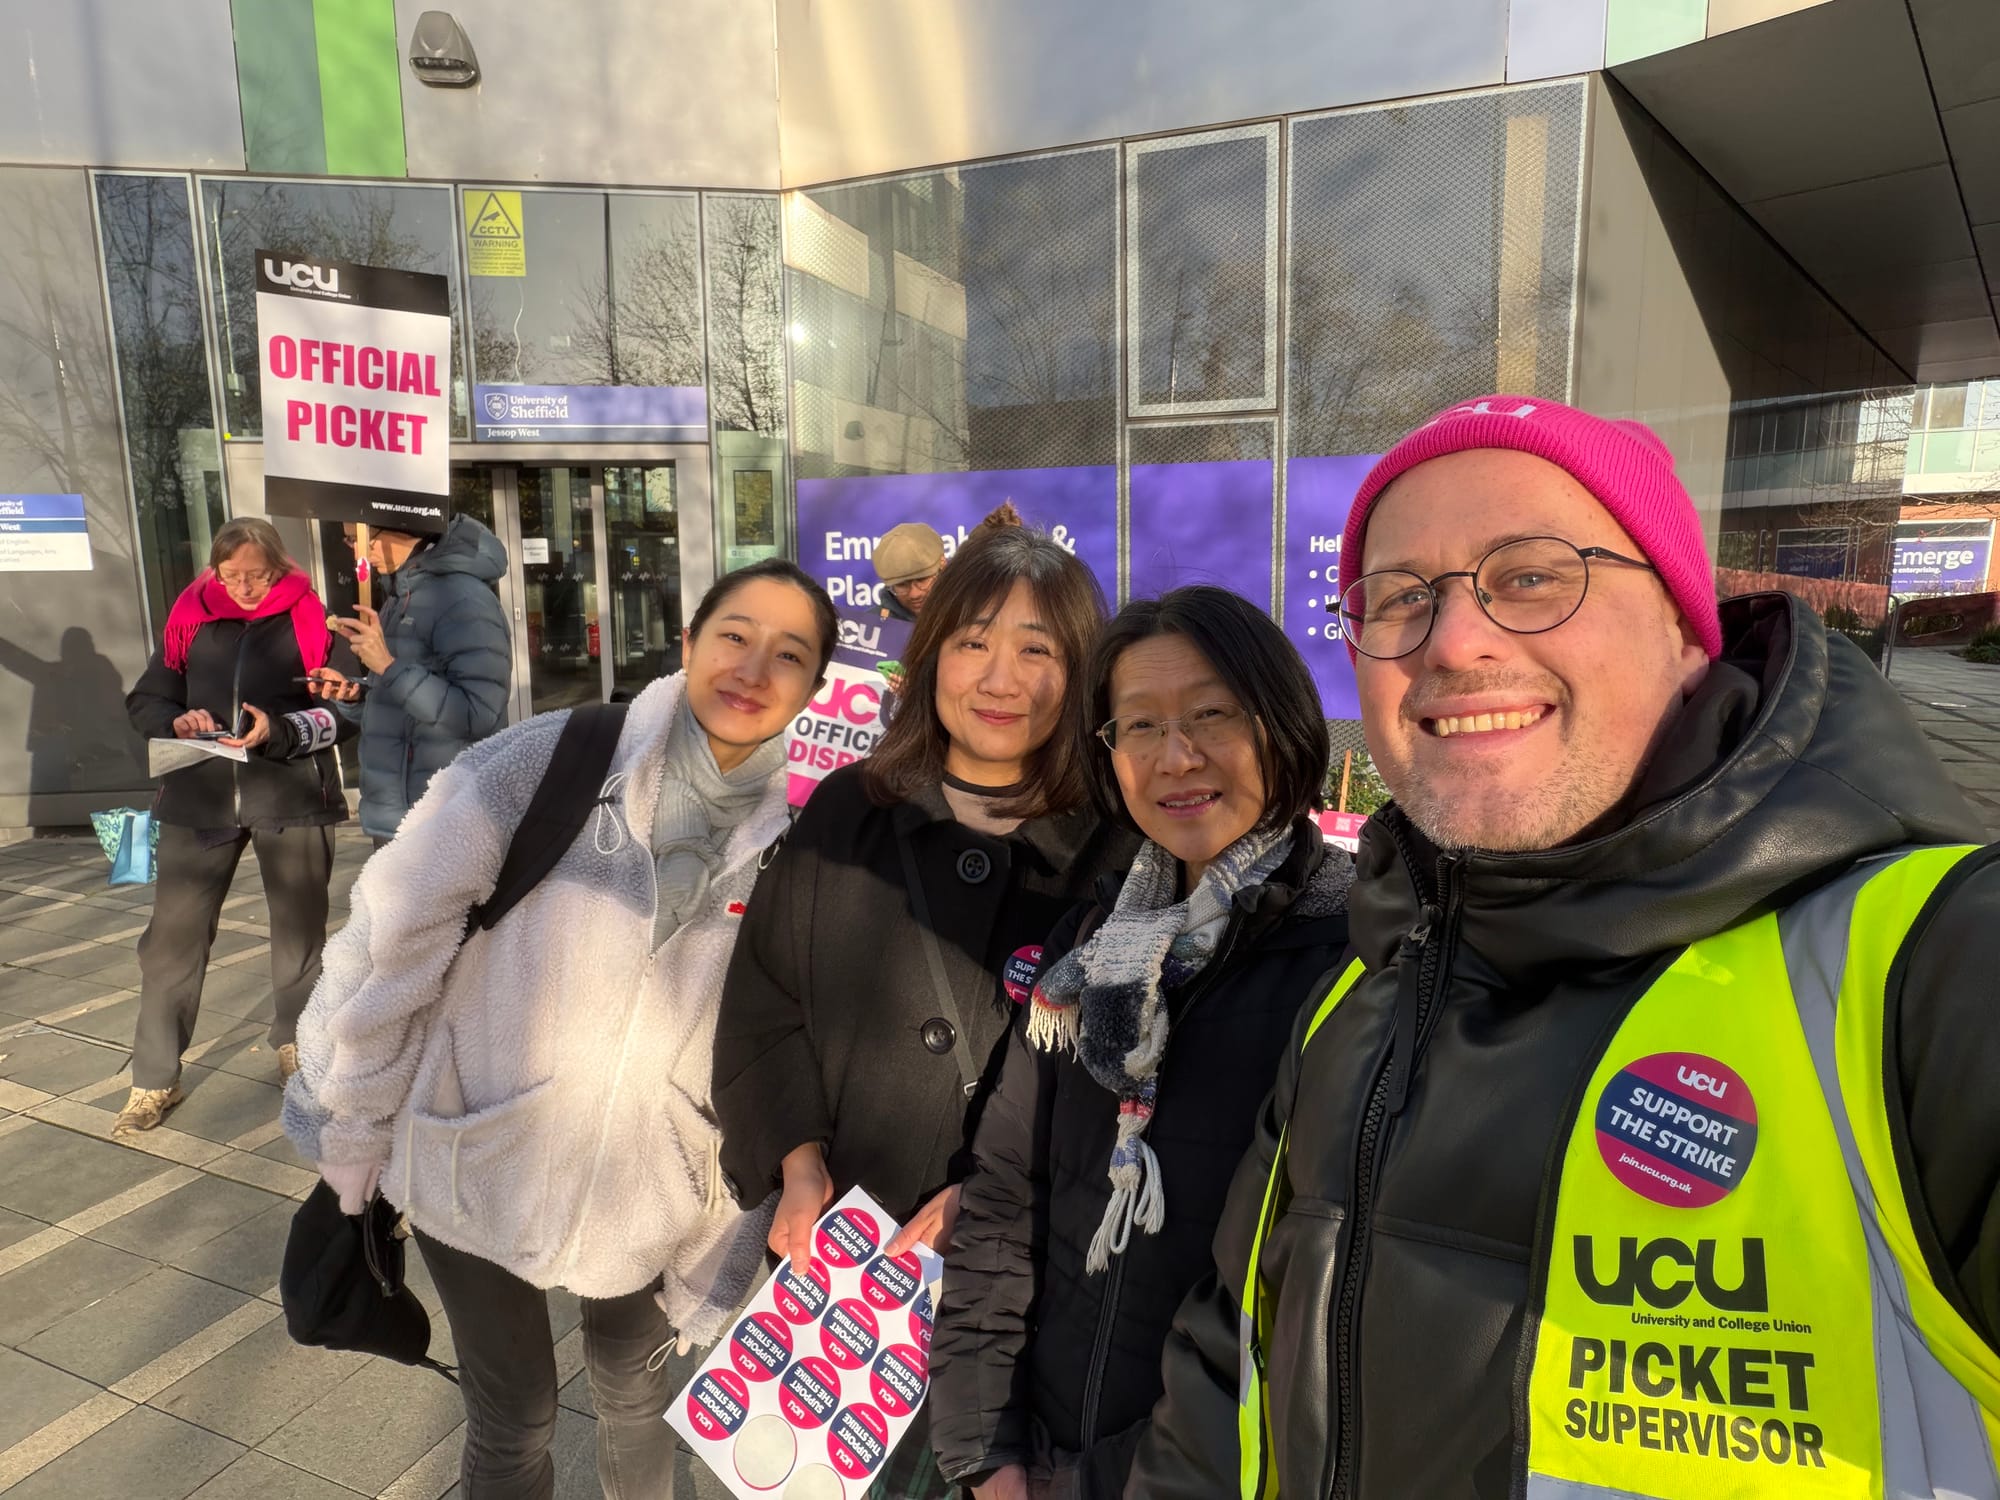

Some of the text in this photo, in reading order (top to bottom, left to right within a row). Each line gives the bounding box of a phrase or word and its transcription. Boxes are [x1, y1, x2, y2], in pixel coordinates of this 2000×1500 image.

[480, 226, 510, 234] CCTV
[473, 240, 519, 248] WARNING
[269, 335, 441, 397] OFFICIAL
[510, 395, 567, 407] University of
[511, 406, 568, 418] Sheffield
[287, 400, 428, 455] PICKET
[488, 428, 539, 439] Jessop West
[372, 502, 441, 517] www.ucu.org.uk
[1310, 534, 1342, 553] Hel
[1893, 547, 1975, 569] Emerge
[795, 717, 880, 753] OFFICI
[788, 738, 864, 771] DISP
[1629, 1086, 1739, 1147] SUPPORT
[1609, 1105, 1737, 1179] THE STRIKE
[1618, 1151, 1693, 1195] join.ucu.org.uk
[833, 1215, 858, 1240] STRIKE
[828, 1226, 861, 1257] SUPPORT
[855, 1236, 872, 1253] THE
[872, 1269, 906, 1297] SUPPORT
[878, 1258, 904, 1281] STRIKE
[900, 1276, 915, 1290] THE
[784, 1278, 817, 1310] SUPPORT
[811, 1288, 825, 1304] THE
[744, 1321, 772, 1348] STRIKE
[832, 1308, 859, 1335] STRIKE
[1631, 1312, 1812, 1334] University and College Union
[740, 1335, 777, 1368] SUPPORT
[829, 1322, 865, 1355] SUPPORT
[856, 1332, 874, 1349] THE
[769, 1343, 786, 1362] THE
[793, 1366, 821, 1394] STRIKE
[882, 1353, 911, 1381] STRIKE
[1568, 1336, 1815, 1412] PICKET
[701, 1377, 729, 1405] STRIKE
[789, 1380, 825, 1414] SUPPORT
[880, 1366, 914, 1401] SUPPORT
[908, 1376, 923, 1394] THE
[697, 1391, 733, 1426] SUPPORT
[725, 1400, 743, 1420] THE
[817, 1389, 834, 1408] THE
[842, 1412, 869, 1442] STRIKE
[1563, 1397, 1826, 1469] SUPERVISOR
[837, 1427, 873, 1463] SUPPORT
[865, 1437, 882, 1457] THE
